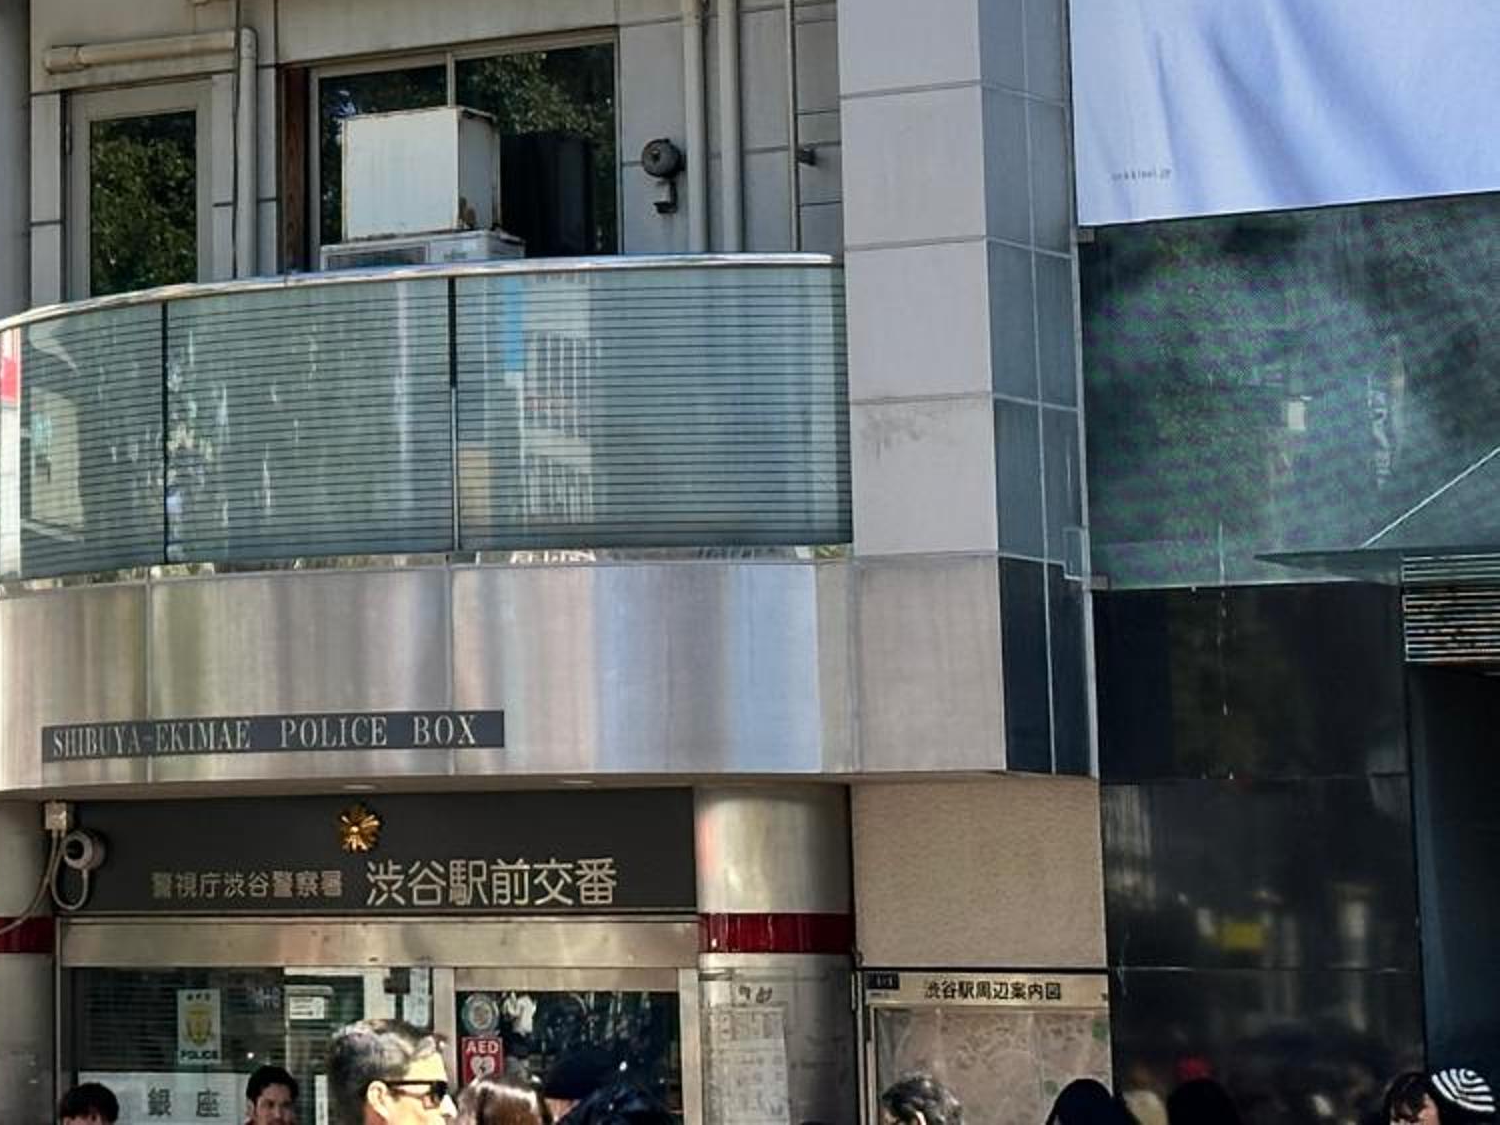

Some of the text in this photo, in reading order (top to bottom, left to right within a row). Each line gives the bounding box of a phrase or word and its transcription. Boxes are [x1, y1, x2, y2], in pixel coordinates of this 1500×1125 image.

[52, 714, 479, 759] SHIBUYA-EKIMAE POLICE BOX
[366, 858, 619, 907] 渋谷駅前交番
[924, 979, 1062, 1001] 渋谷駅周辺案内図
[466, 1039, 500, 1054] AED
